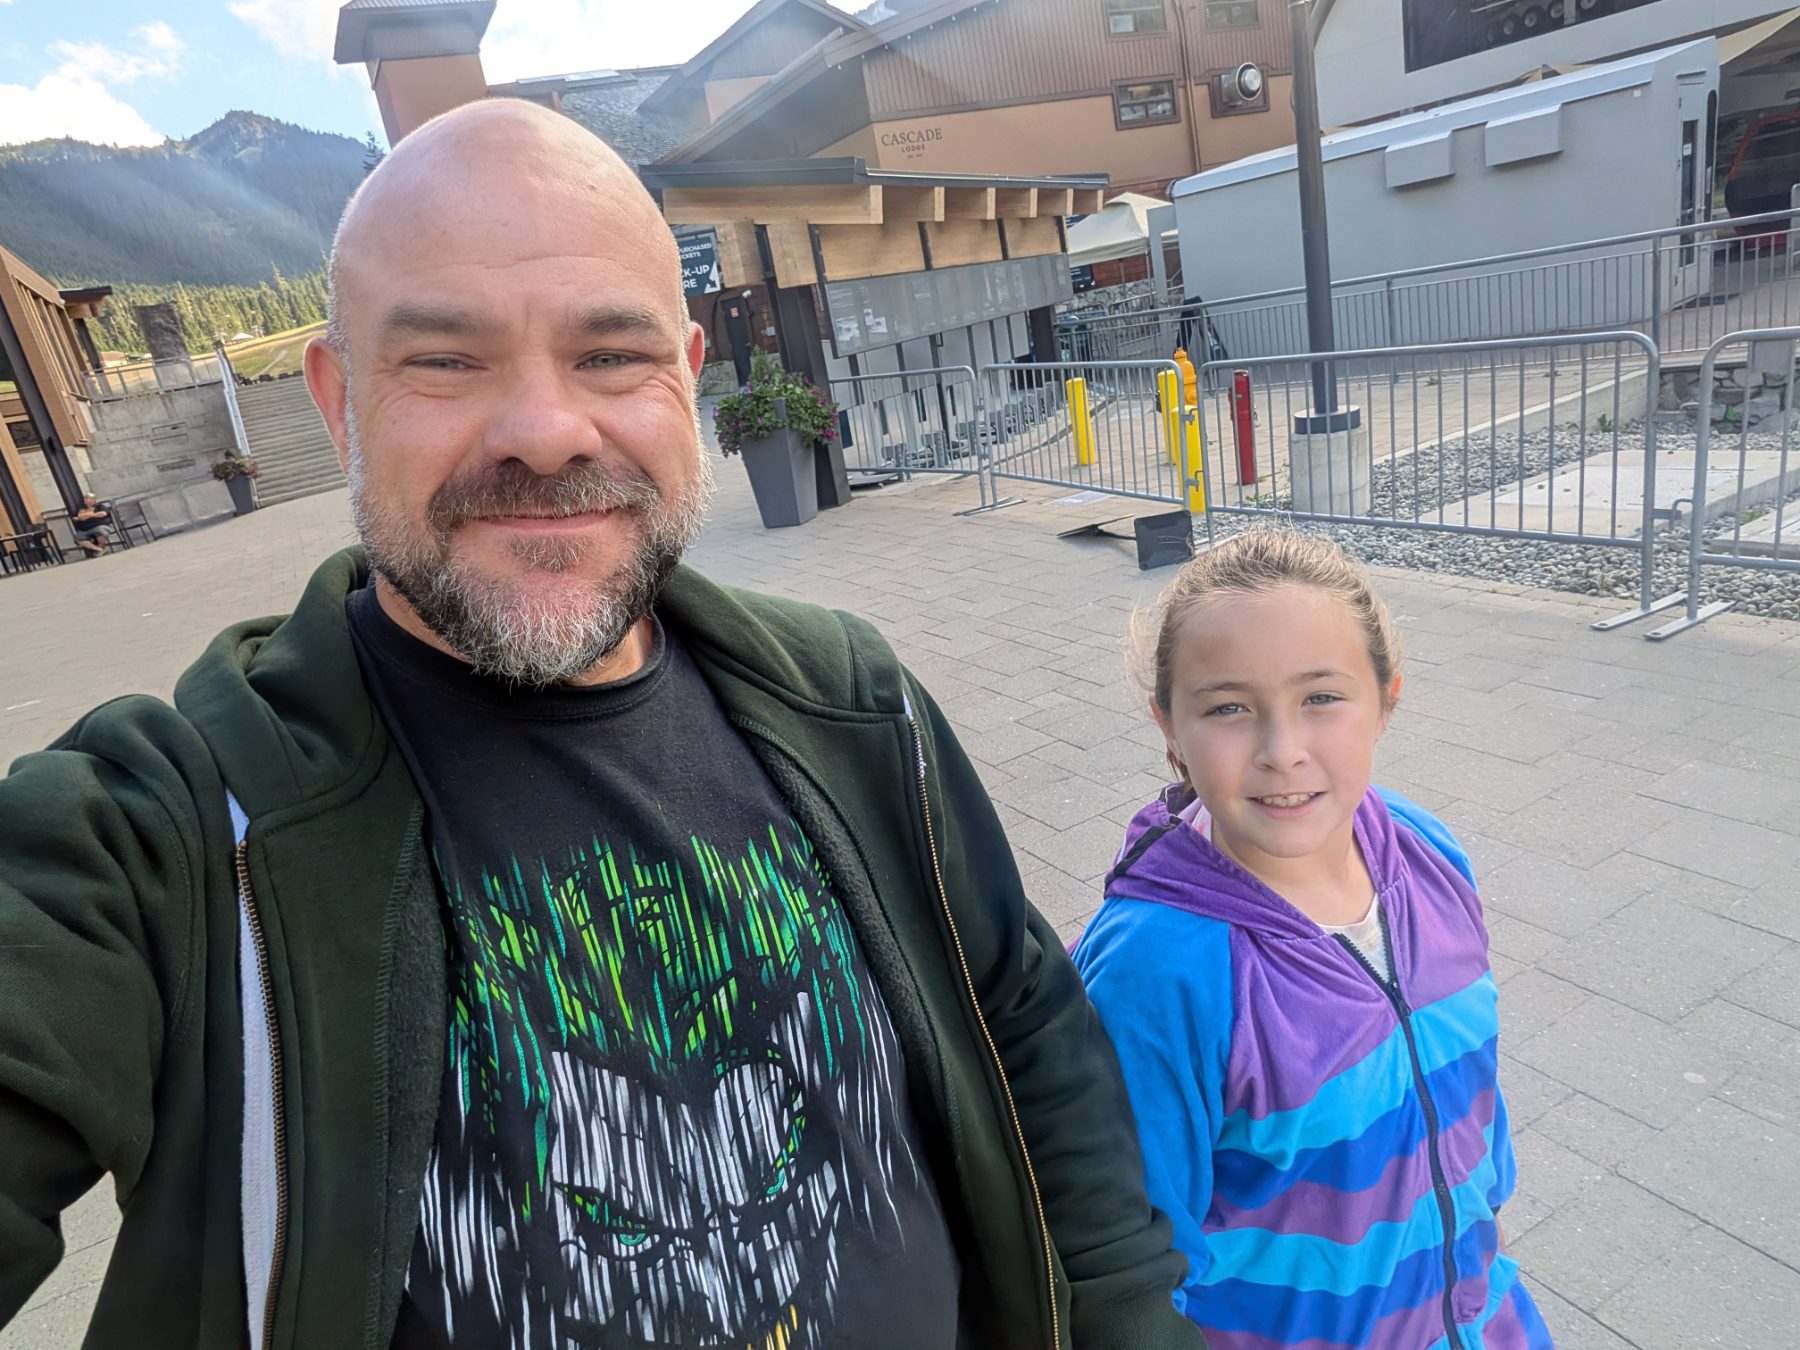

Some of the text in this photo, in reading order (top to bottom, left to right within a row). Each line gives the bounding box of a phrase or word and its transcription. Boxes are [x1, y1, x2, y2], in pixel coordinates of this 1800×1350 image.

[881, 128, 943, 146] CASCADE
[901, 144, 925, 153] LODGE
[680, 243, 712, 253] URCHASED
[682, 251, 701, 259] CKETS
[682, 265, 710, 278] K-UP
[683, 279, 698, 289] RE
